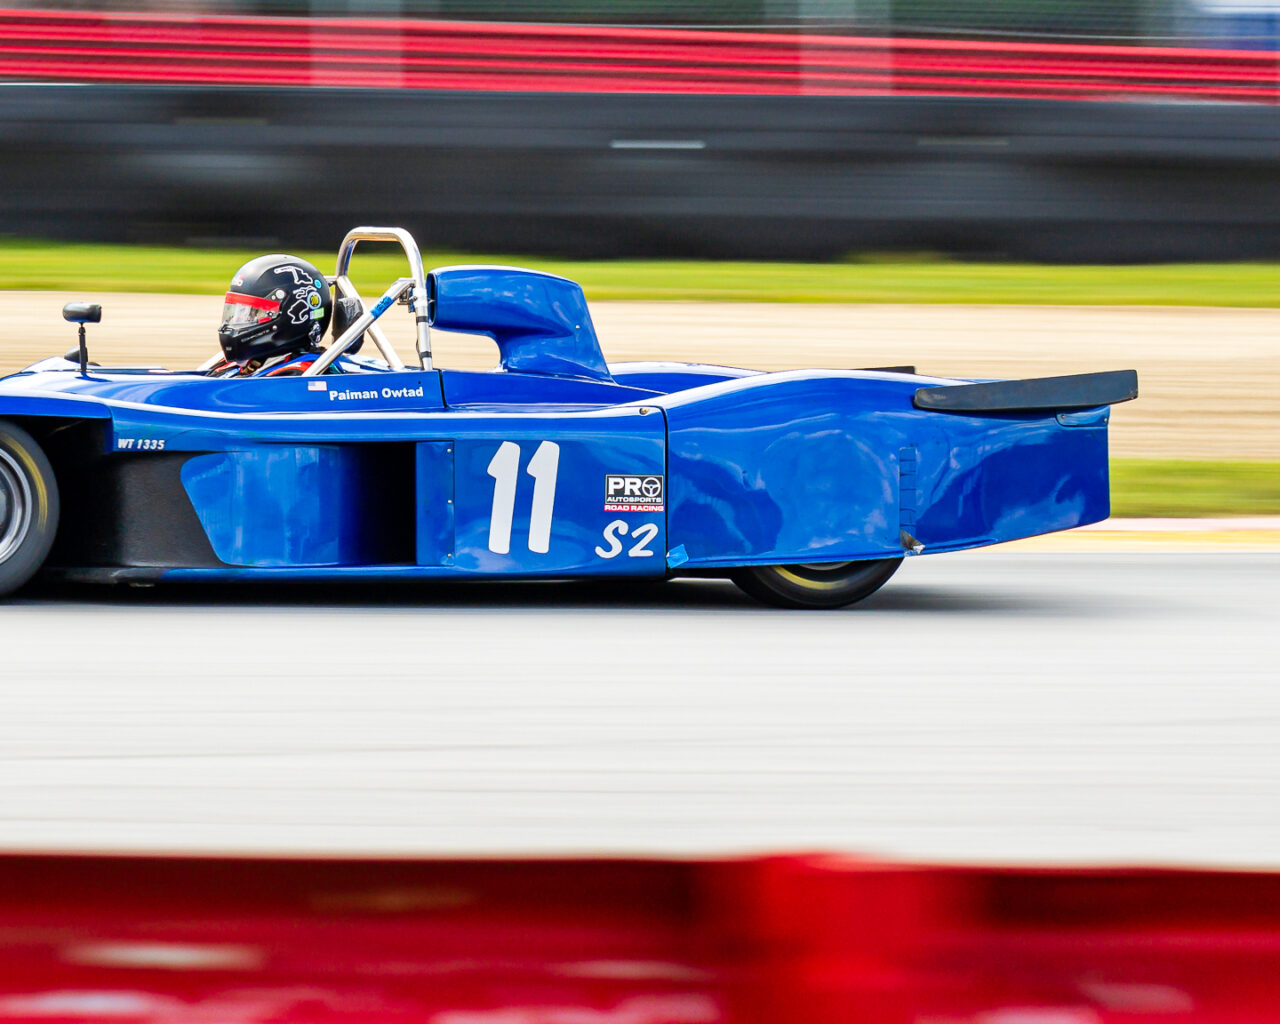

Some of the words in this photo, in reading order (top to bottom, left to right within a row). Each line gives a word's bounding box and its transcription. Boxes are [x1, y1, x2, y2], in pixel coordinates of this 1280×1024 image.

[329, 389, 379, 401] Paiman
[381, 386, 424, 398] Owtad
[118, 438, 135, 449] WT
[137, 439, 165, 450] 1335
[487, 440, 560, 554] 11
[608, 477, 661, 497] PRO
[595, 519, 659, 559] S2
